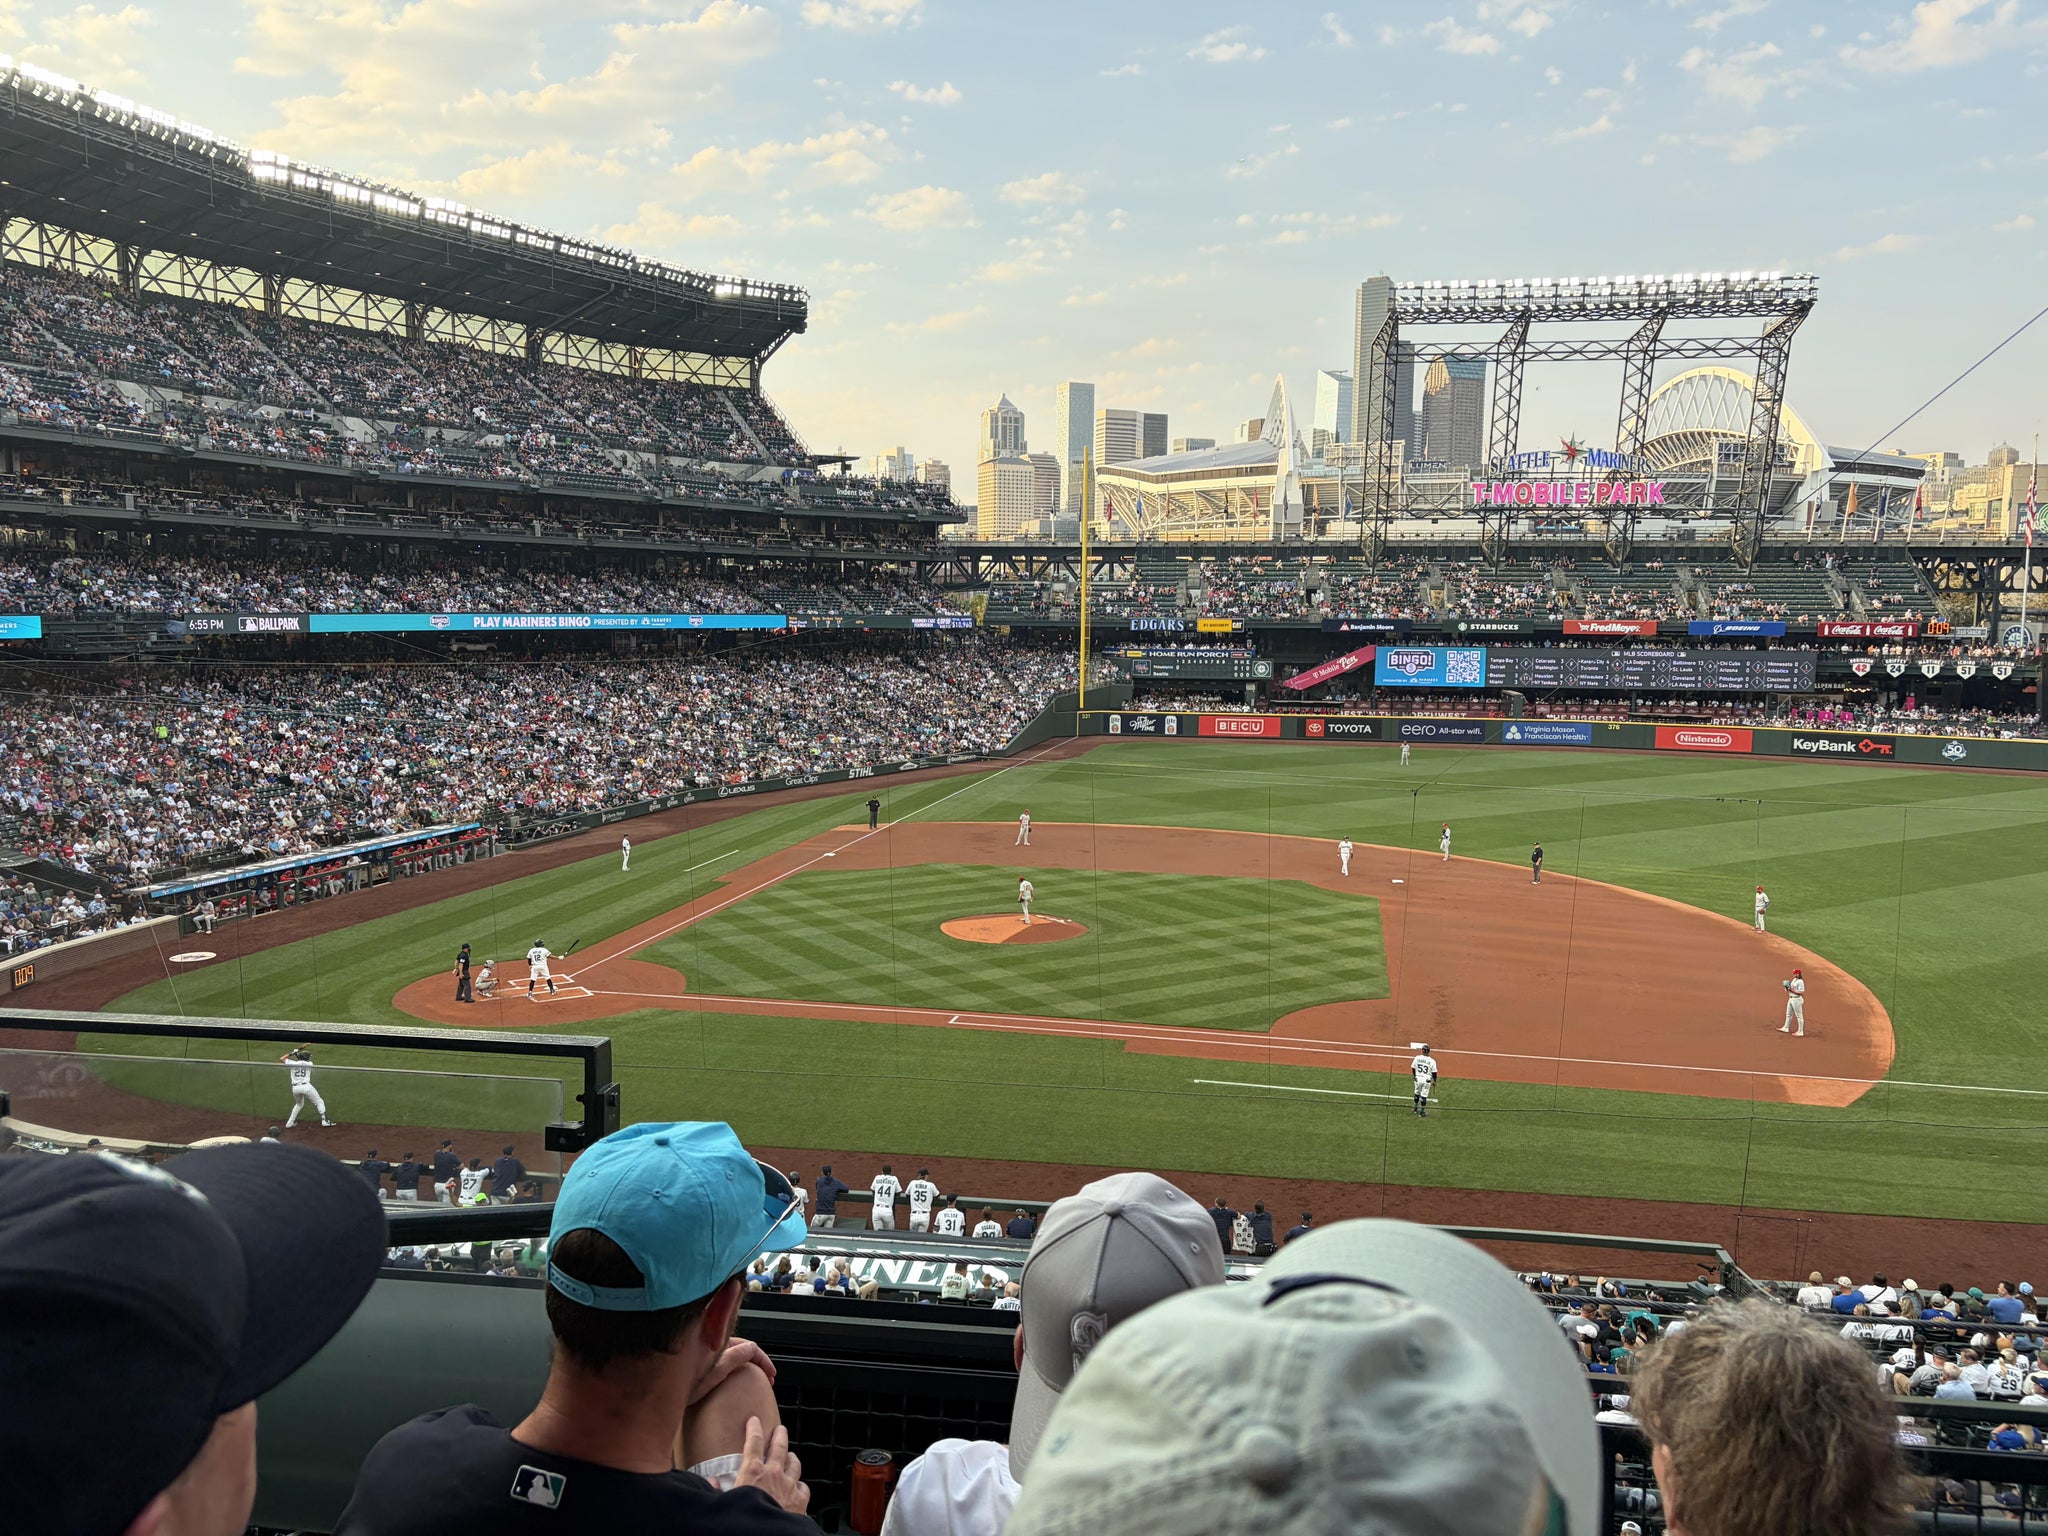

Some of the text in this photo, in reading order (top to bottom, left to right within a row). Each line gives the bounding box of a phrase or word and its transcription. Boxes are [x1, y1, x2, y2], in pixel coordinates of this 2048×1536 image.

[1490, 448, 1652, 475] SEATTLE MARINERS
[1471, 481, 1666, 504] T-MOBILE PARK
[189, 619, 224, 631] 6:55 PM
[258, 618, 300, 631] BALLPARK
[473, 616, 501, 628] PLAY
[502, 616, 557, 627] MARINERS
[558, 616, 591, 627] BINGO
[594, 618, 630, 626] PRESENTED
[1131, 618, 1184, 631] EDGARS
[1470, 623, 1519, 631] STARBUCKS
[1831, 625, 1863, 635] Coca-Cola
[1873, 625, 1905, 636] Coca-Cola
[1928, 622, 1950, 635] 0:09
[1390, 654, 1432, 666] BINGO!
[1320, 664, 1340, 678] Mobile
[1855, 665, 1867, 673] 42
[1890, 665, 1902, 673] 24
[1926, 666, 1935, 674] 11
[1961, 666, 1972, 675] 51
[1997, 667, 2007, 676] 51
[1219, 722, 1261, 731] BECU
[1328, 724, 1372, 734] TOYOTA
[1401, 725, 1436, 736] eero
[1438, 727, 1465, 735] All-star
[1524, 726, 1551, 734] Virginia
[1680, 734, 1727, 744] Nintendo
[1793, 738, 1857, 753] KeyBank
[1947, 744, 1963, 754] 50
[848, 766, 875, 779] STIHL
[785, 774, 819, 786] Great Clips
[728, 785, 756, 795] LEXUS
[295, 1068, 307, 1078] 29
[1418, 1064, 1429, 1074] 53
[463, 1179, 477, 1190] 27
[877, 1186, 891, 1198] 44
[914, 1190, 928, 1202] 35
[945, 1220, 956, 1231] 31
[1896, 1329, 1911, 1340] 44
[2002, 1379, 2017, 1391] 29
